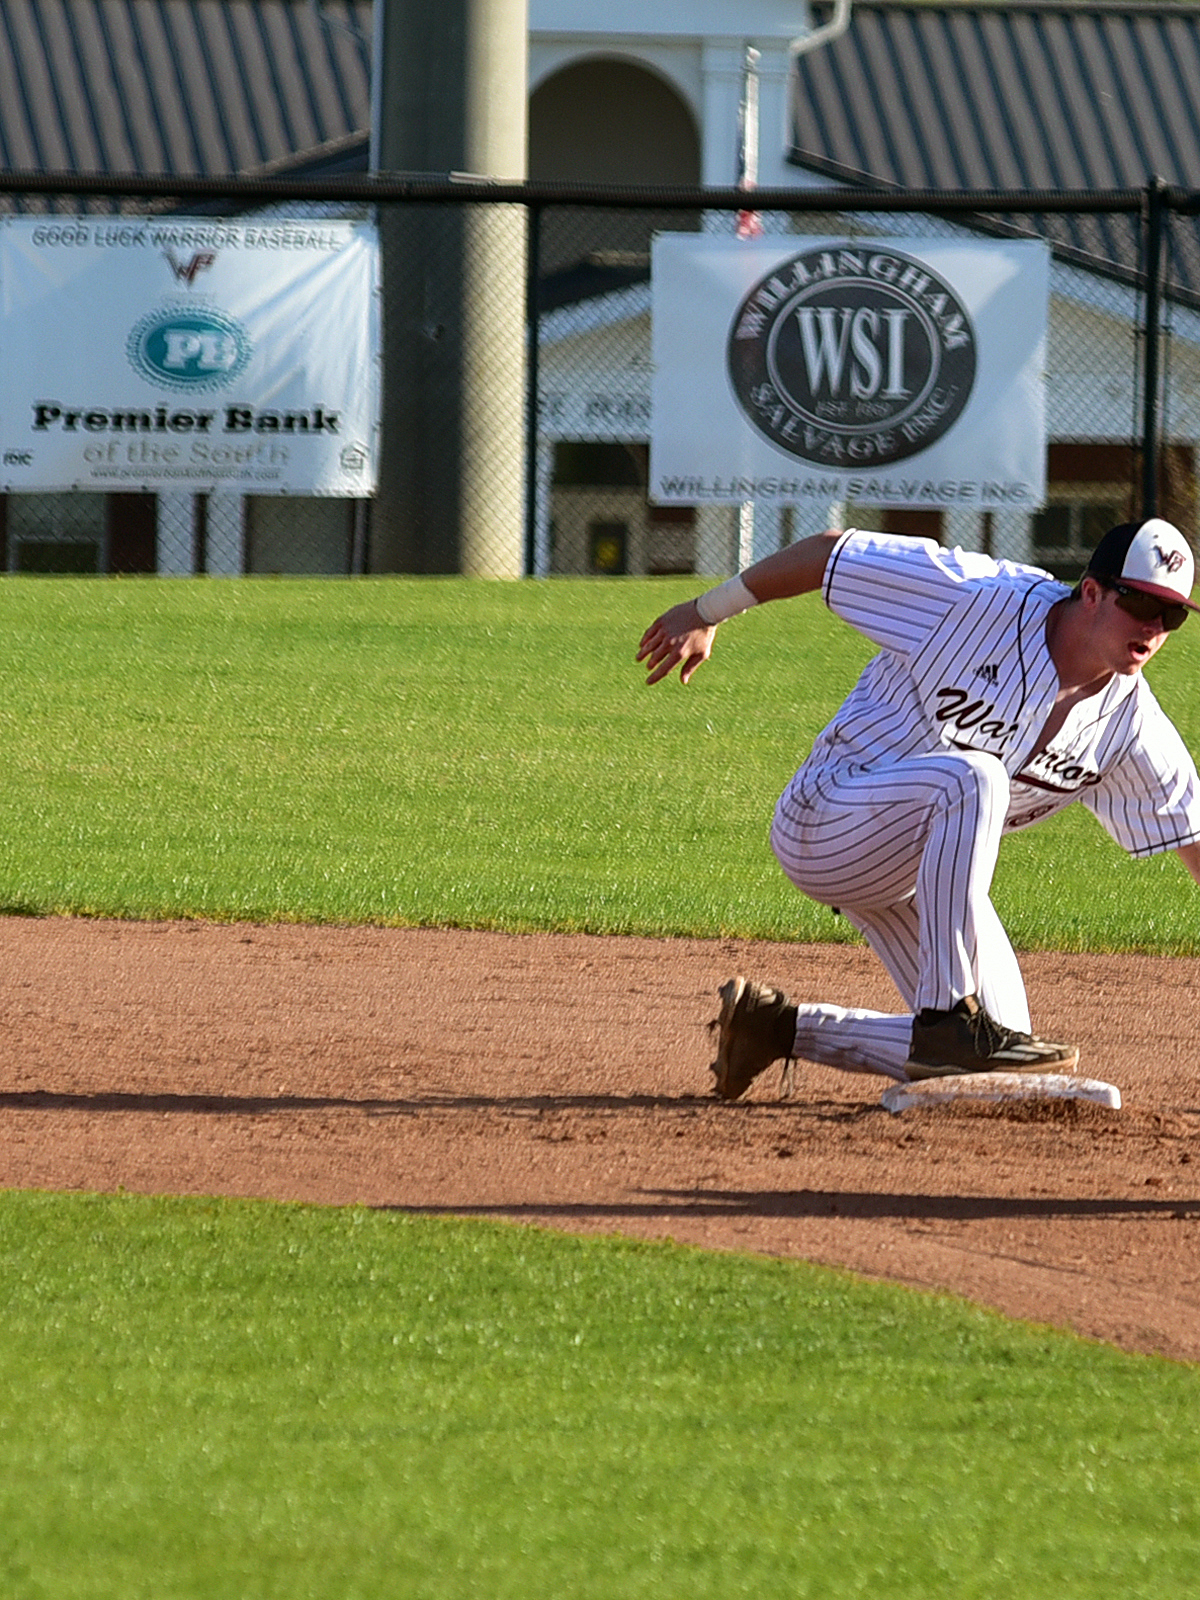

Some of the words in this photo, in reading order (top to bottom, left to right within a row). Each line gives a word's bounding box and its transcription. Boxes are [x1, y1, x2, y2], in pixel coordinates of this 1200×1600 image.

[32, 225, 89, 247] GOOD
[94, 226, 147, 248] LUCK
[151, 226, 241, 249] WARRIOR
[243, 227, 342, 250] BASEBALL
[733, 249, 973, 352] WILLINGHAM
[795, 305, 914, 401] WSI
[32, 399, 216, 434] Premier
[222, 402, 345, 435] Bank
[750, 381, 898, 461] SALVAGE
[82, 440, 121, 465] of
[127, 440, 181, 466] the
[188, 441, 290, 467] South
[660, 474, 840, 499] WILLINGHAM
[846, 477, 976, 501] SALVAGE
